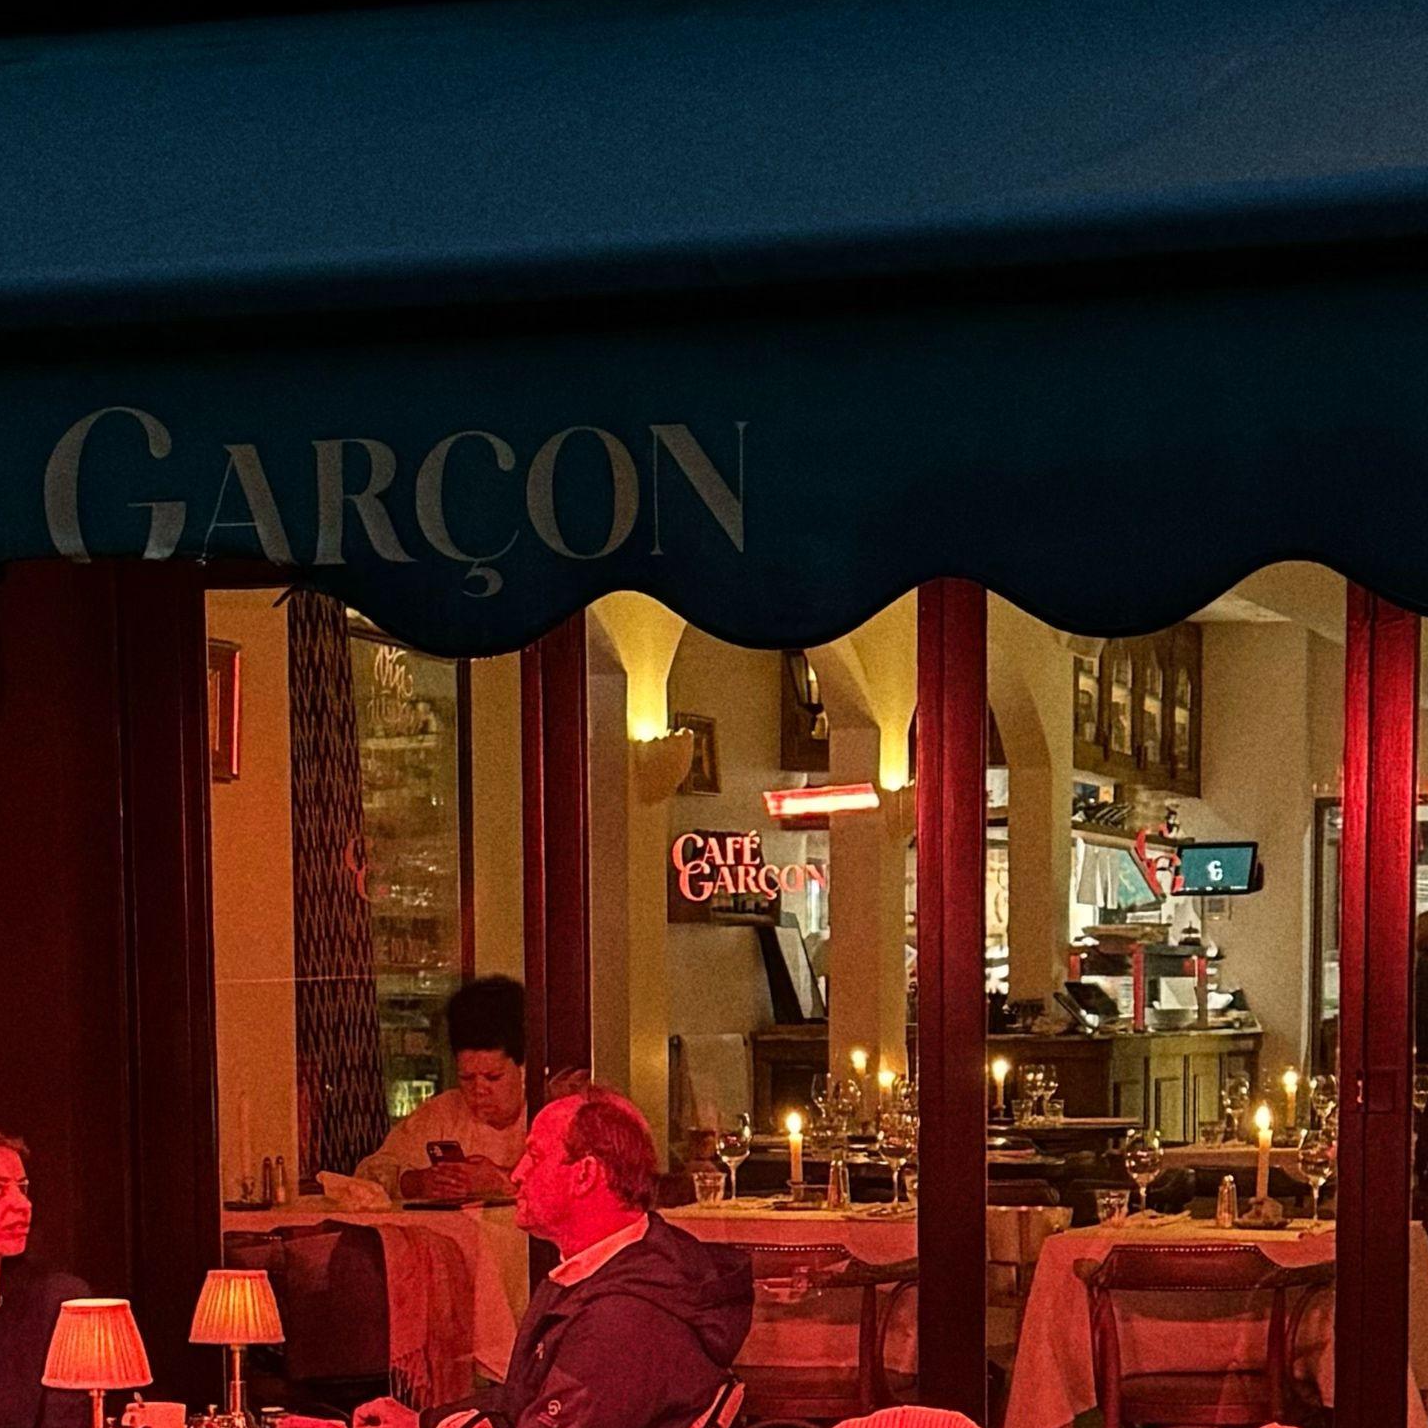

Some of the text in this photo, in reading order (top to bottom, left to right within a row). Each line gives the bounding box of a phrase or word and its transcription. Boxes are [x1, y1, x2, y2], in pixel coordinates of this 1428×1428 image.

[43, 405, 749, 598] GARÇON
[672, 829, 761, 873] CAFÉ
[678, 860, 827, 902] GARÇON
